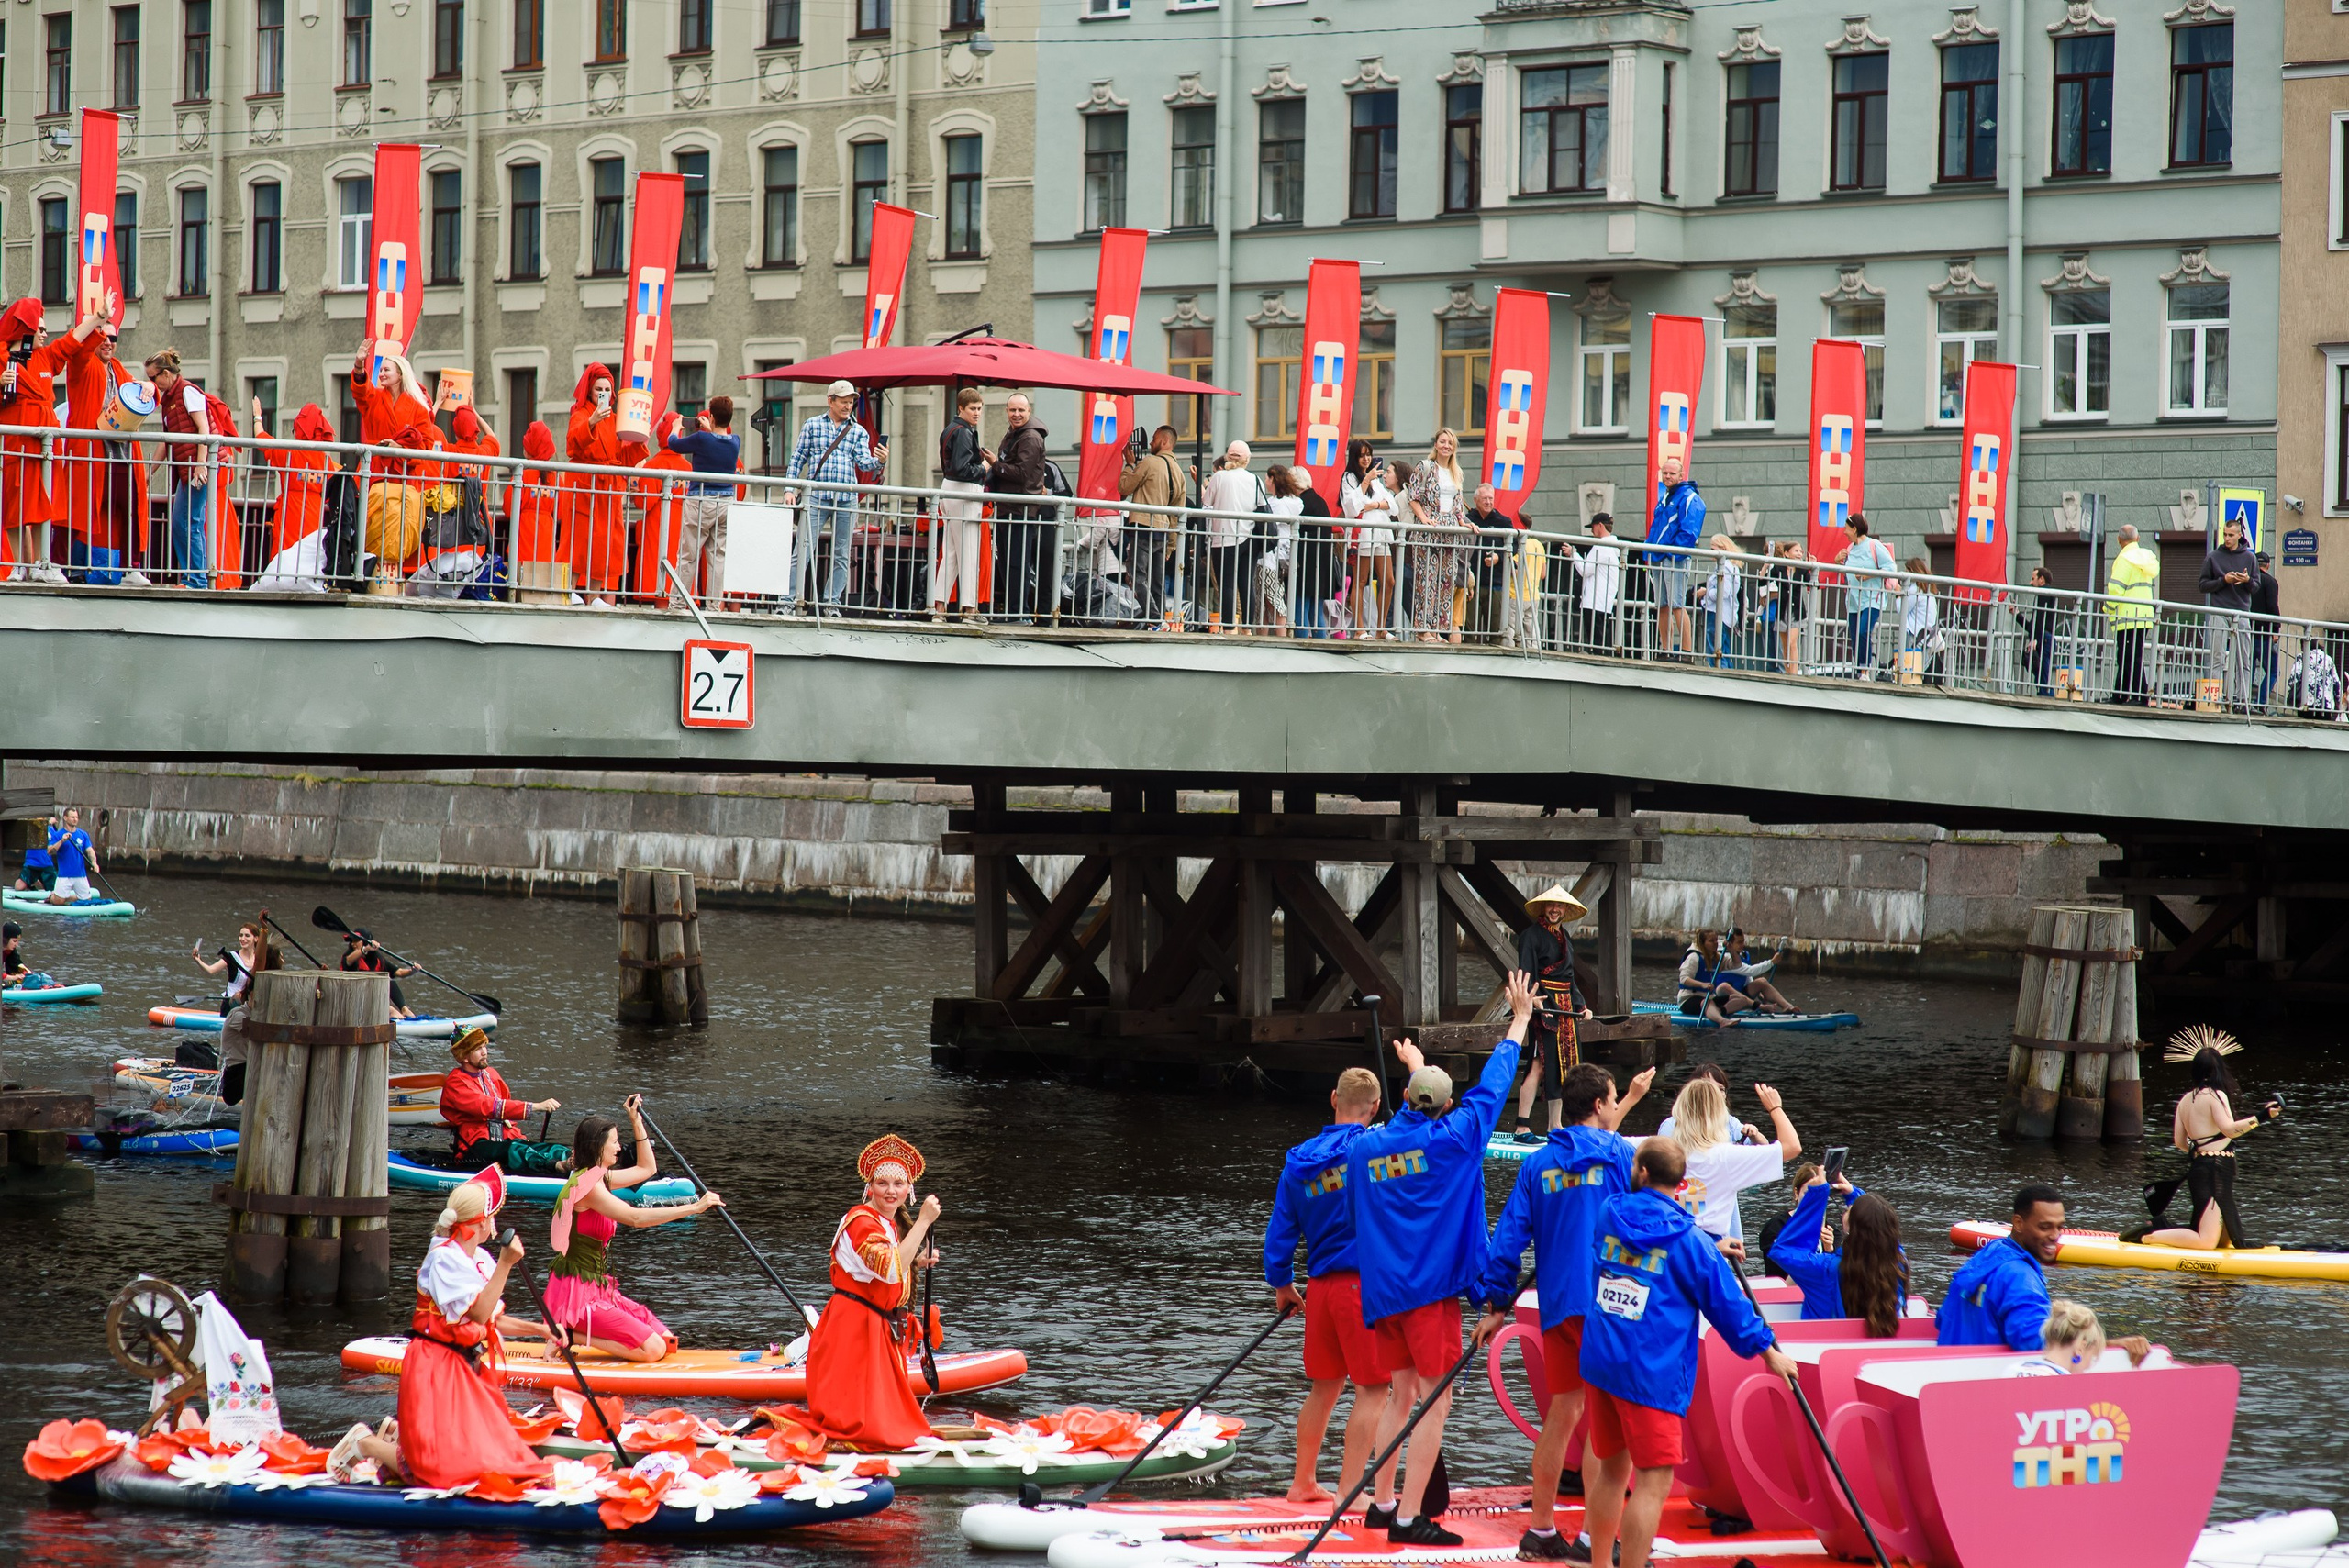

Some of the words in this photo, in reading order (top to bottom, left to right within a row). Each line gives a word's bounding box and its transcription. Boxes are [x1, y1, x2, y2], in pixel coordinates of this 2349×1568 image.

[82, 212, 108, 321] ТН
[1306, 341, 1345, 467] ТНТ
[1492, 369, 1533, 491] ТНТ
[1656, 391, 1689, 503] ТН
[1819, 414, 1854, 528] ТНТ
[1966, 433, 2001, 544] ТНТ
[692, 672, 744, 713] 2.7
[172, 1084, 191, 1093] 02625
[1368, 1149, 1429, 1183] ТНТ
[2176, 1258, 2221, 1273] ACOWAY
[1602, 1288, 1639, 1307] 02124
[375, 1359, 403, 1375] SHA
[2015, 1408, 2115, 1446] УТРО
[2013, 1441, 2124, 1489] ТНТ
